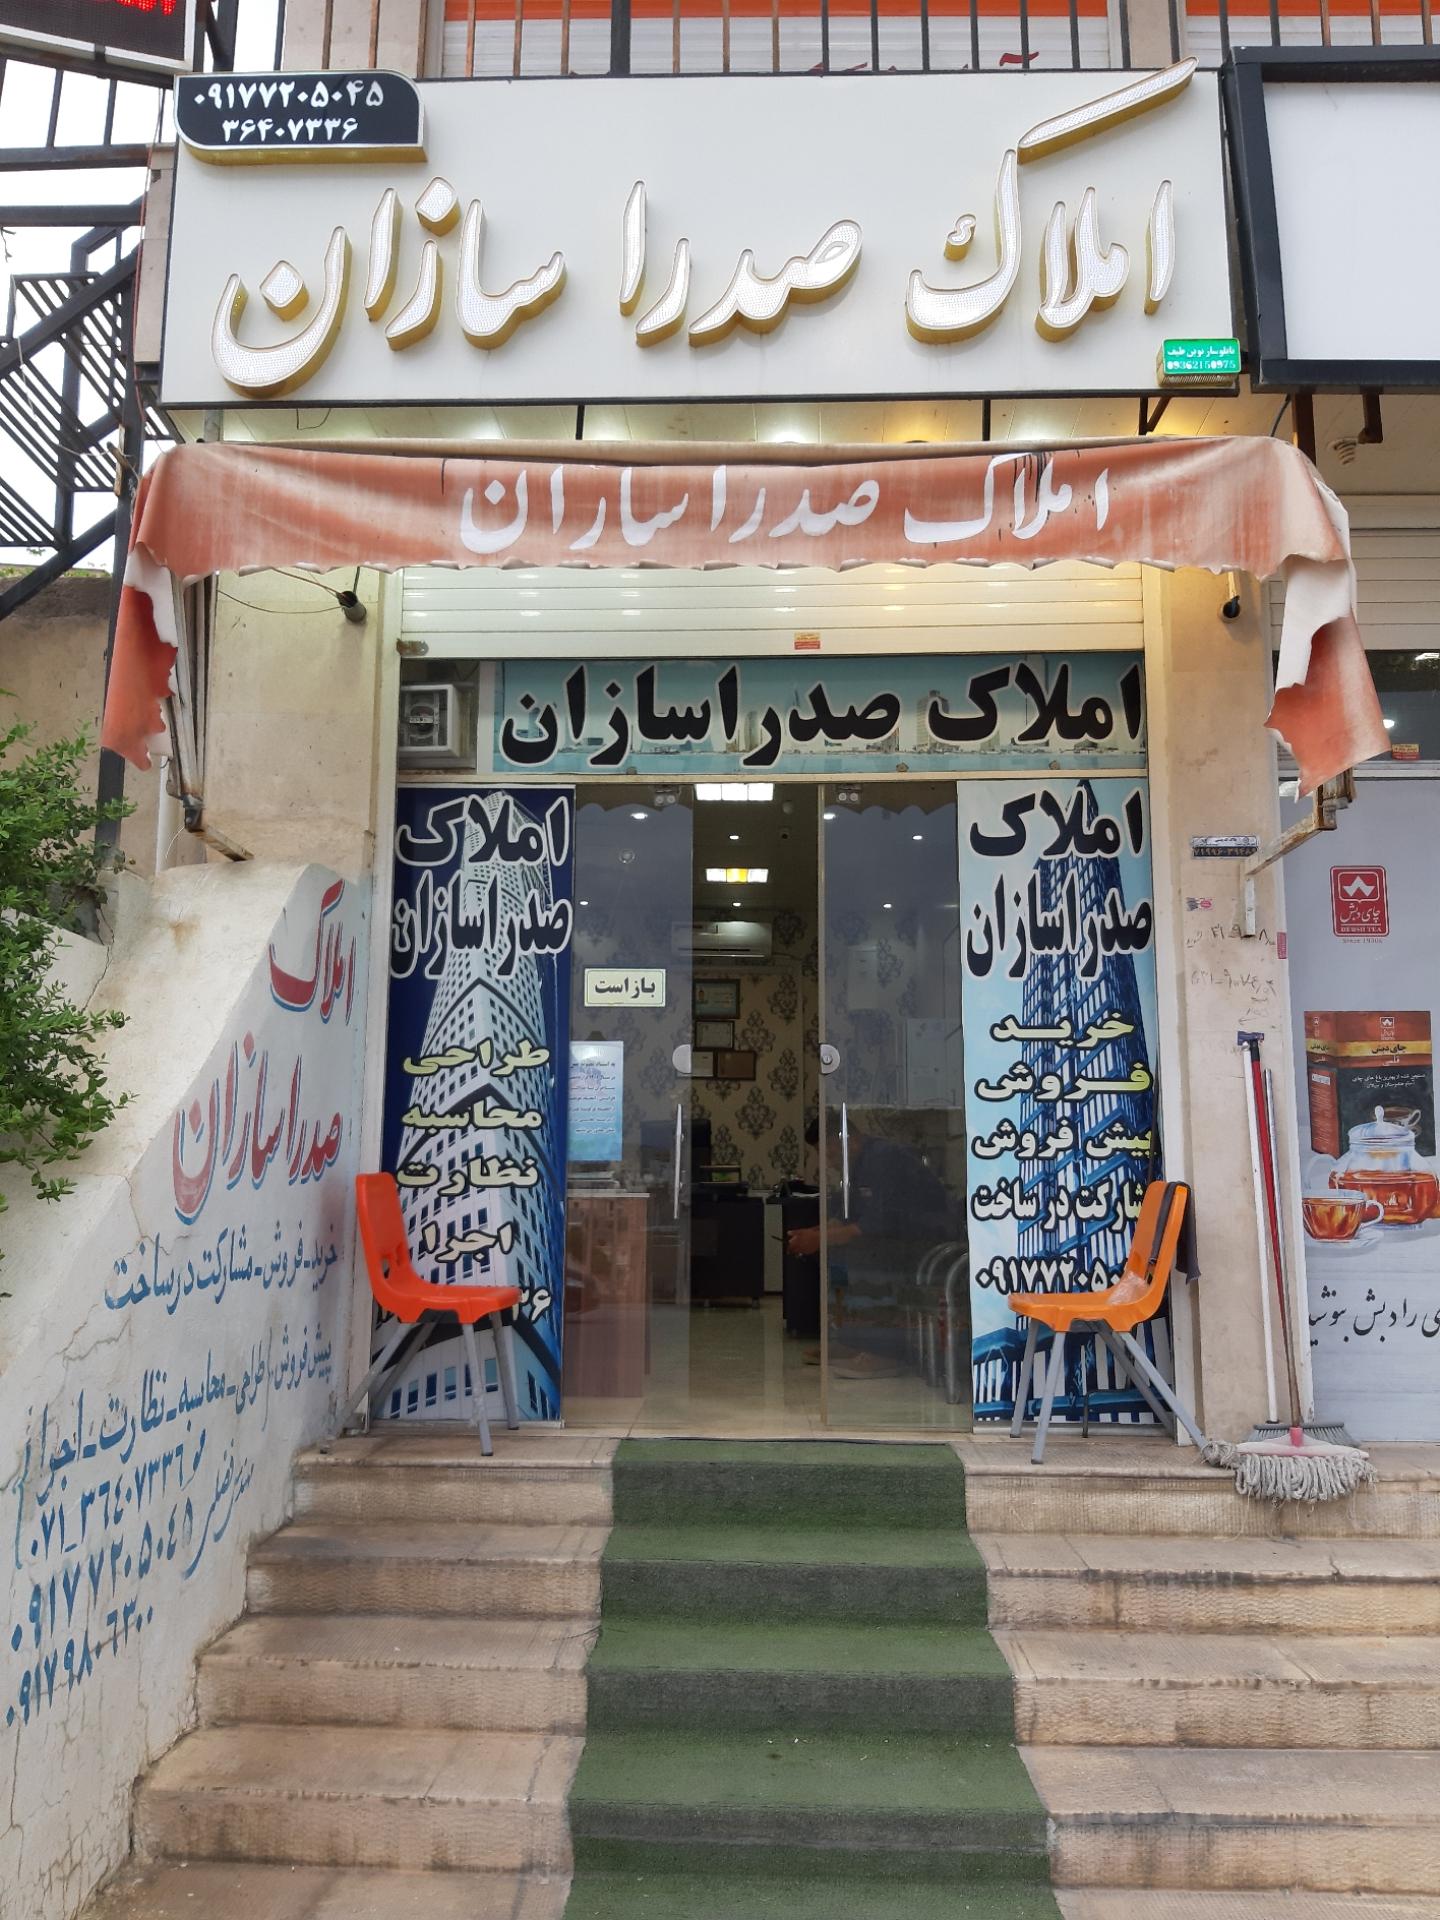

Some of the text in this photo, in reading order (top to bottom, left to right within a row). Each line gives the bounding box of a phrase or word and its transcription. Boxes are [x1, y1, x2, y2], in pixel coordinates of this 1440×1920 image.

[193, 79, 385, 110] ۰۹۱۷۷۲۰۵۰۴۵
[221, 117, 359, 143] ۳۶۴۰۷۳۳۶
[211, 175, 569, 397] سازان
[619, 179, 864, 348] صدرا
[711, 464, 880, 543] صدرا
[500, 661, 1143, 769] املاک صدرا سازان
[396, 794, 570, 867] املاک
[968, 788, 1144, 858] املاک
[389, 866, 573, 980] صدرا سازان
[966, 870, 1152, 978] صدرا سازان
[1339, 902, 1381, 925] چای دبش
[268, 878, 357, 1027] املاک
[594, 977, 656, 999] باز است
[402, 1038, 550, 1076] طراحی
[991, 1011, 1135, 1048] خرید
[975, 1061, 1152, 1100] فروش
[172, 1030, 344, 1227] صدرا سازان
[401, 1099, 543, 1135] محاسبه
[973, 1118, 1076, 1159] فروش
[396, 1155, 540, 1197] نظارت
[972, 1177, 1146, 1231] شارکت در ساخت
[104, 1219, 338, 1316] خرید فروش مشارکت در ساخت
[421, 1220, 514, 1263] اجرا
[975, 1257, 1128, 1293] ۰۹۱۷۷۲۰۵۰
[1405, 1297, 1418, 1328] را
[177, 1348, 226, 1433] محاسبه
[235, 1338, 267, 1415] طراحی
[273, 1323, 308, 1391] فروش
[99, 1368, 168, 1465] نظارت
